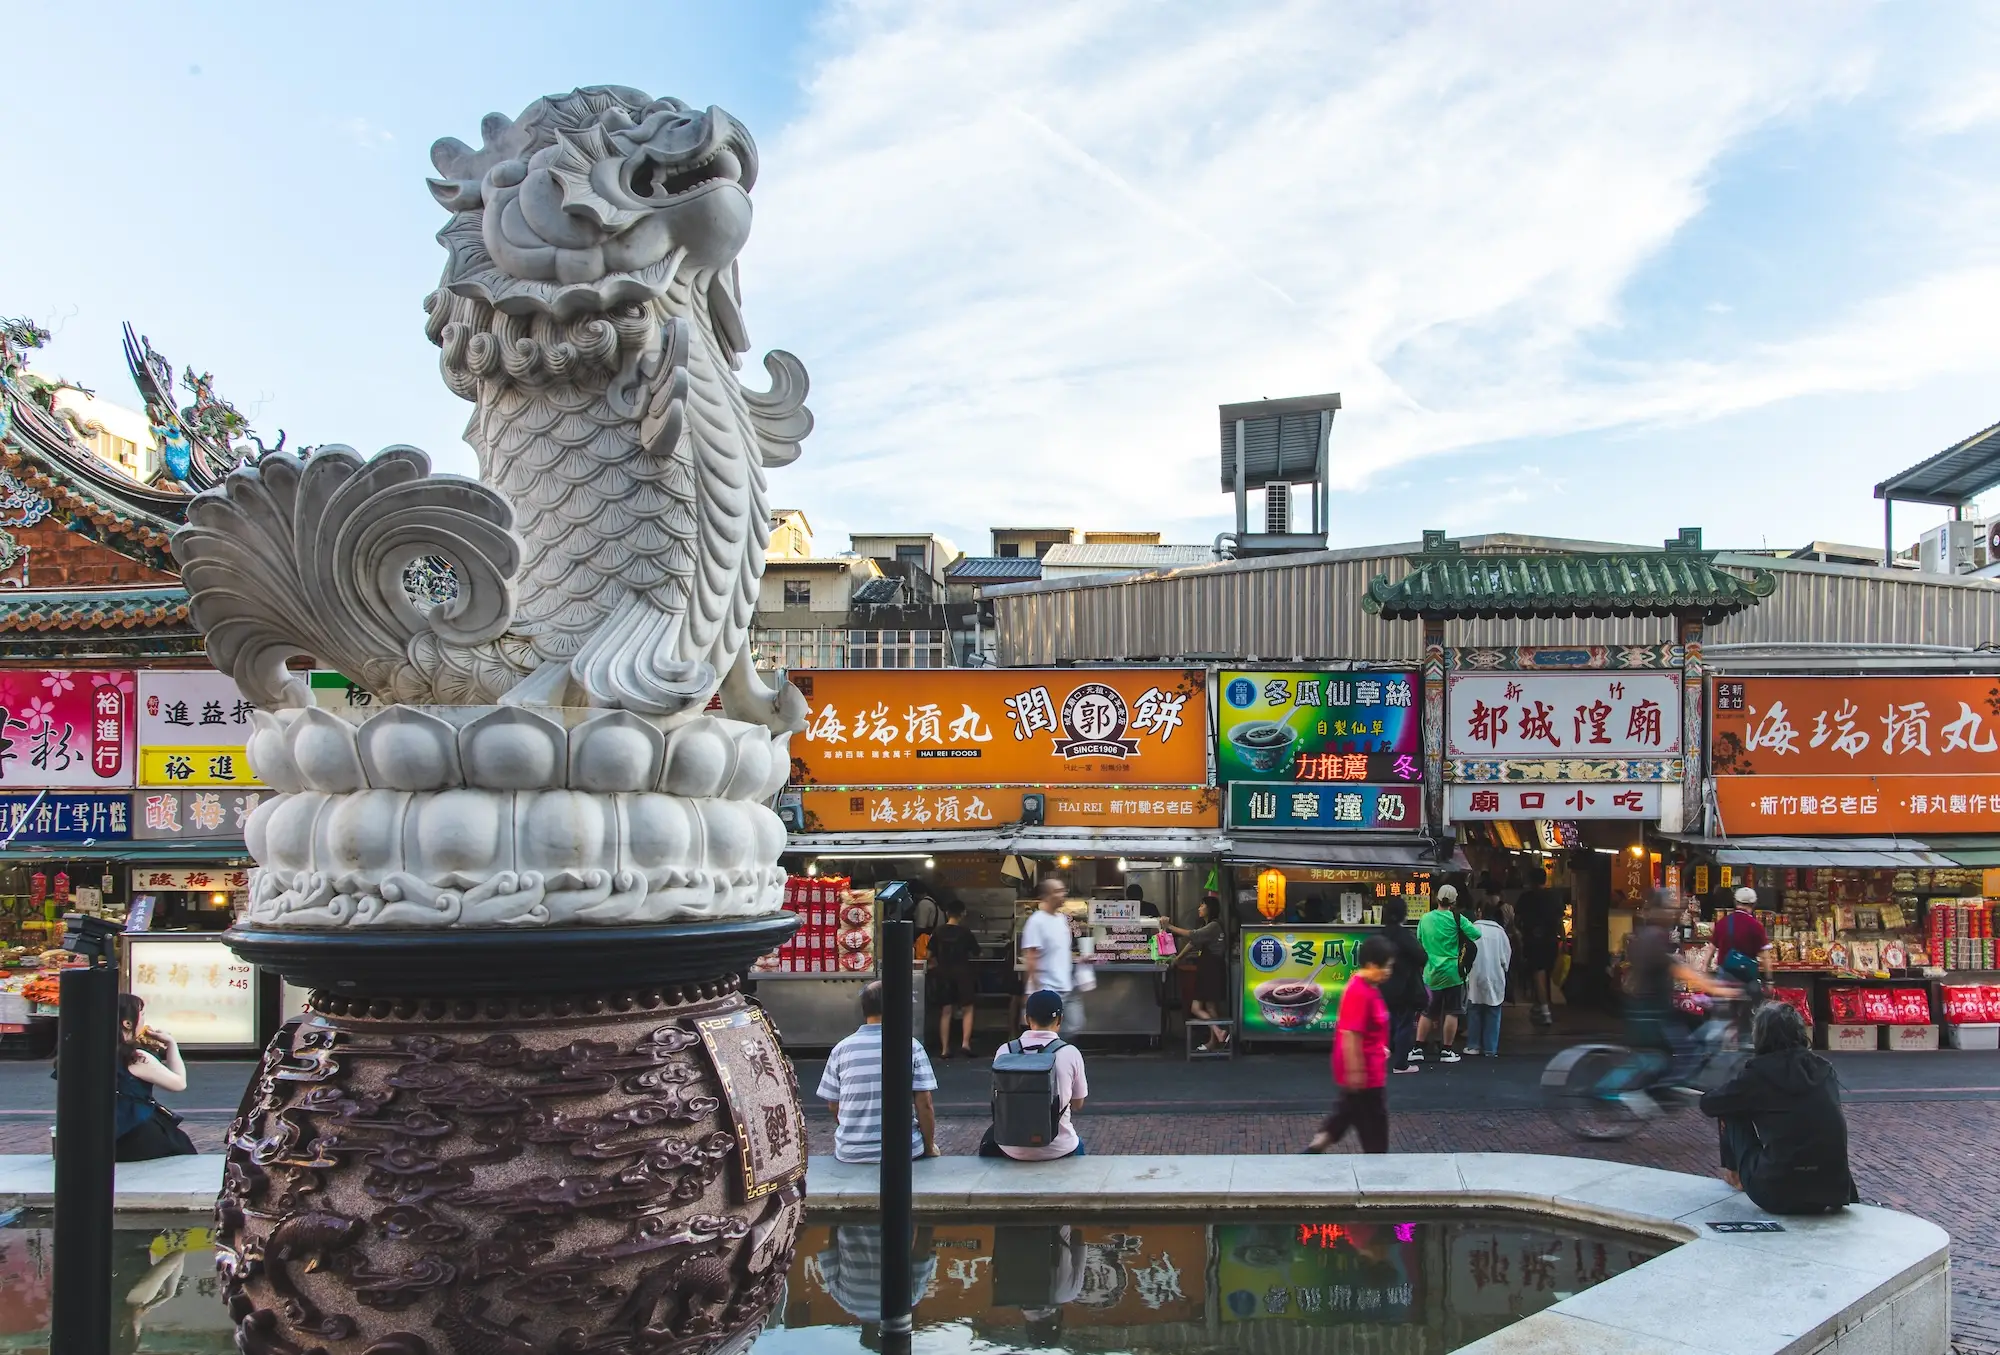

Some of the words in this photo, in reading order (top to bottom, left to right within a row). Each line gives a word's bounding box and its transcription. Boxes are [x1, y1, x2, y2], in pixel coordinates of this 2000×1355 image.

[1265, 679, 1412, 707] 冬瓜仙草絲
[805, 701, 994, 746] 海瑞摃丸
[1004, 686, 1058, 741] 潤
[1131, 686, 1188, 743] 餅
[1080, 701, 1110, 735] 郭
[1317, 720, 1384, 736] 自製仙草
[1467, 698, 1662, 749] 都城隍廟
[96, 692, 120, 769] 裕進行
[1745, 698, 1998, 759] 海瑞摃丸
[824, 750, 865, 759] 海納百味
[1073, 745, 1118, 755] SINCE1906
[165, 755, 260, 780] 裕進
[1295, 753, 1368, 780] 力推薦
[1392, 754, 1423, 780] 冬
[870, 795, 993, 824] 海瑞摃丸
[1058, 803, 1080, 812] HAI
[1083, 803, 1102, 812] REI
[1110, 800, 1193, 815] 新竹馳名老店
[1249, 792, 1405, 820] 仙草撞奶
[1469, 790, 1643, 812] 廟口小吃
[1760, 796, 1878, 815] 新竹馳名老店
[1376, 882, 1430, 897] 仙草撞奶
[1626, 857, 1642, 900] 瑞摃丸
